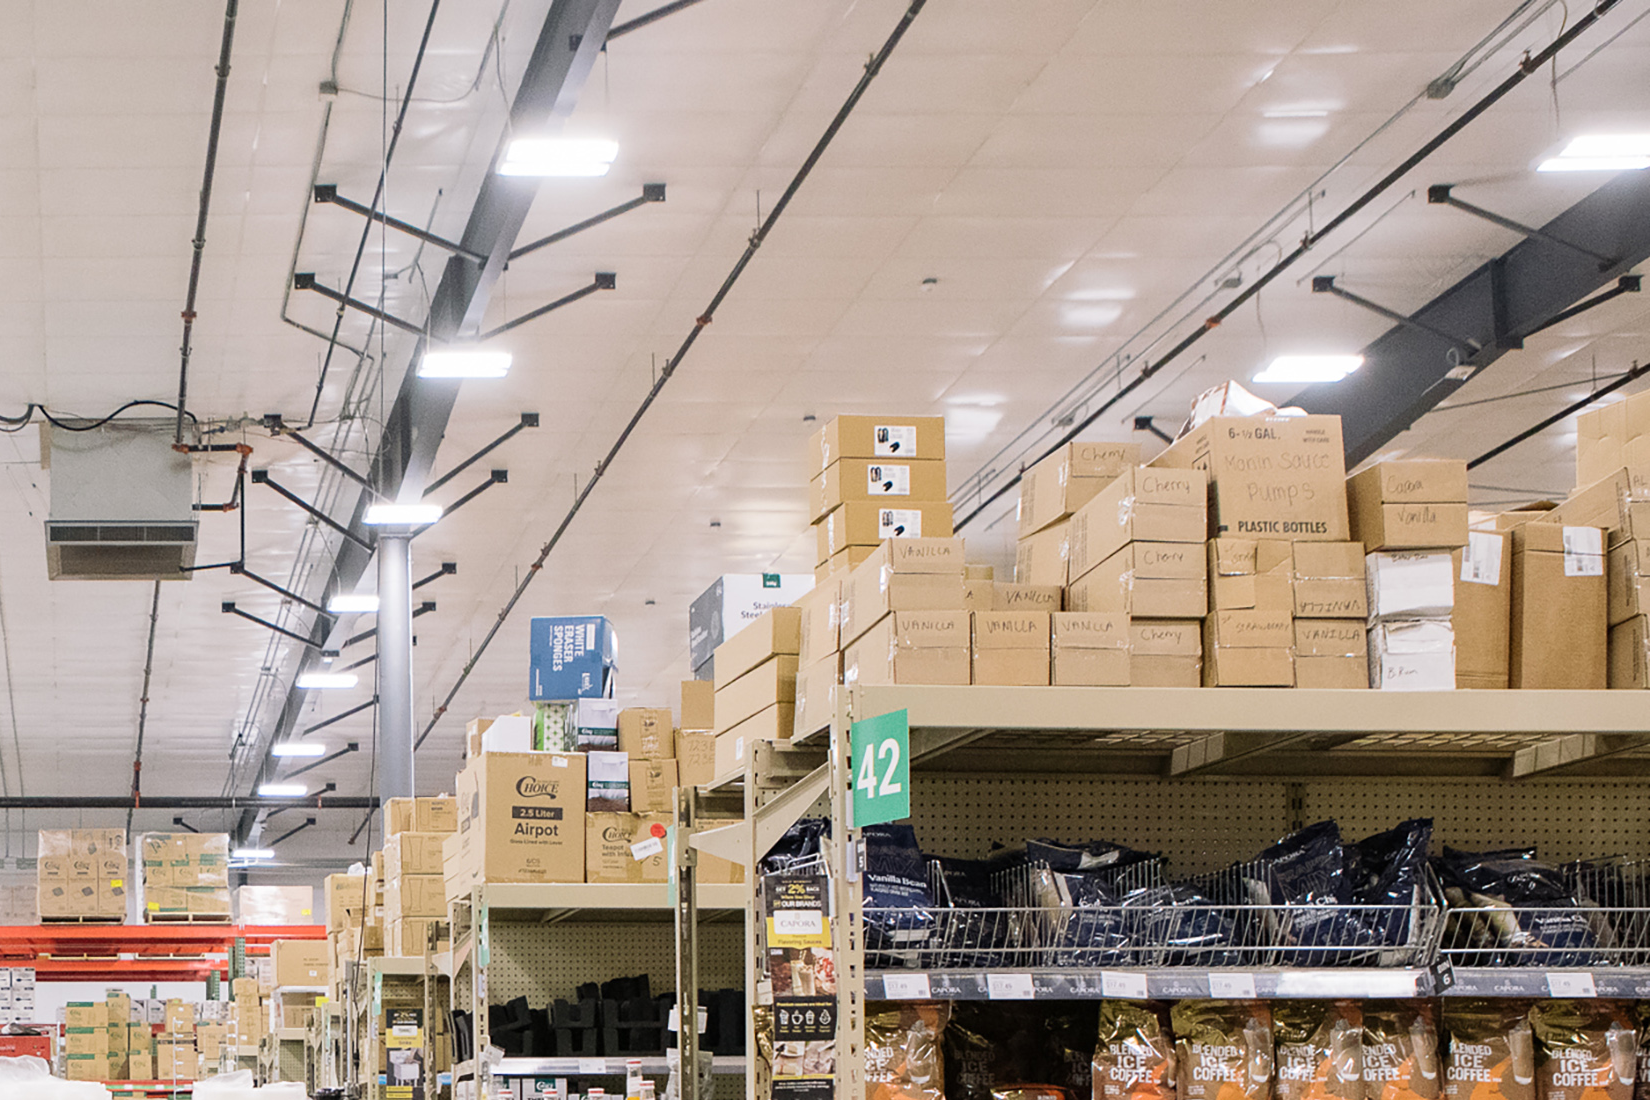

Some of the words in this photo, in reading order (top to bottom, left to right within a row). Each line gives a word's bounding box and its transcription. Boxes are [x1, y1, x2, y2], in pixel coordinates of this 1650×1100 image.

[1254, 427, 1281, 439] GAL.
[1142, 477, 1190, 494] Cherry
[1238, 521, 1280, 533] PLASTIC
[1283, 521, 1328, 533] BOTTLES
[900, 545, 950, 558] VANILLA
[902, 620, 955, 632] VANILLA
[987, 621, 1037, 633] VANILLA
[1062, 621, 1114, 632] VANILLA
[575, 624, 585, 657] WHITE
[1140, 630, 1181, 645] Cherry
[1303, 629, 1361, 641] VANILLA
[552, 625, 564, 672] SPONGES
[564, 625, 574, 663] ERASER
[858, 738, 900, 799] 42
[515, 775, 559, 800] CHOICE
[520, 809, 534, 817] 2.5
[535, 809, 555, 817] Liter
[514, 823, 559, 838] Airpot
[602, 844, 624, 852] Teapot
[867, 874, 901, 884] Vanilla
[902, 877, 927, 889] Bean
[787, 884, 806, 894] 2%
[1443, 974, 1450, 985] 6
[1192, 1045, 1237, 1057] BLENDED
[1552, 1049, 1593, 1061] BLENDED
[1117, 1057, 1147, 1069] ICE
[1200, 1056, 1229, 1069] ICE
[1287, 1057, 1316, 1069] ICE
[1362, 1056, 1390, 1068] ICE
[1454, 1055, 1483, 1067] ICE
[1560, 1060, 1589, 1073] ICE
[962, 1063, 989, 1073] ICE
[1363, 1067, 1400, 1081] OFFEE
[1110, 1069, 1153, 1083] COFFEE
[1192, 1068, 1237, 1083] COFFEE
[1447, 1067, 1491, 1082] COFFEE
[1553, 1073, 1598, 1087] COFFEE
